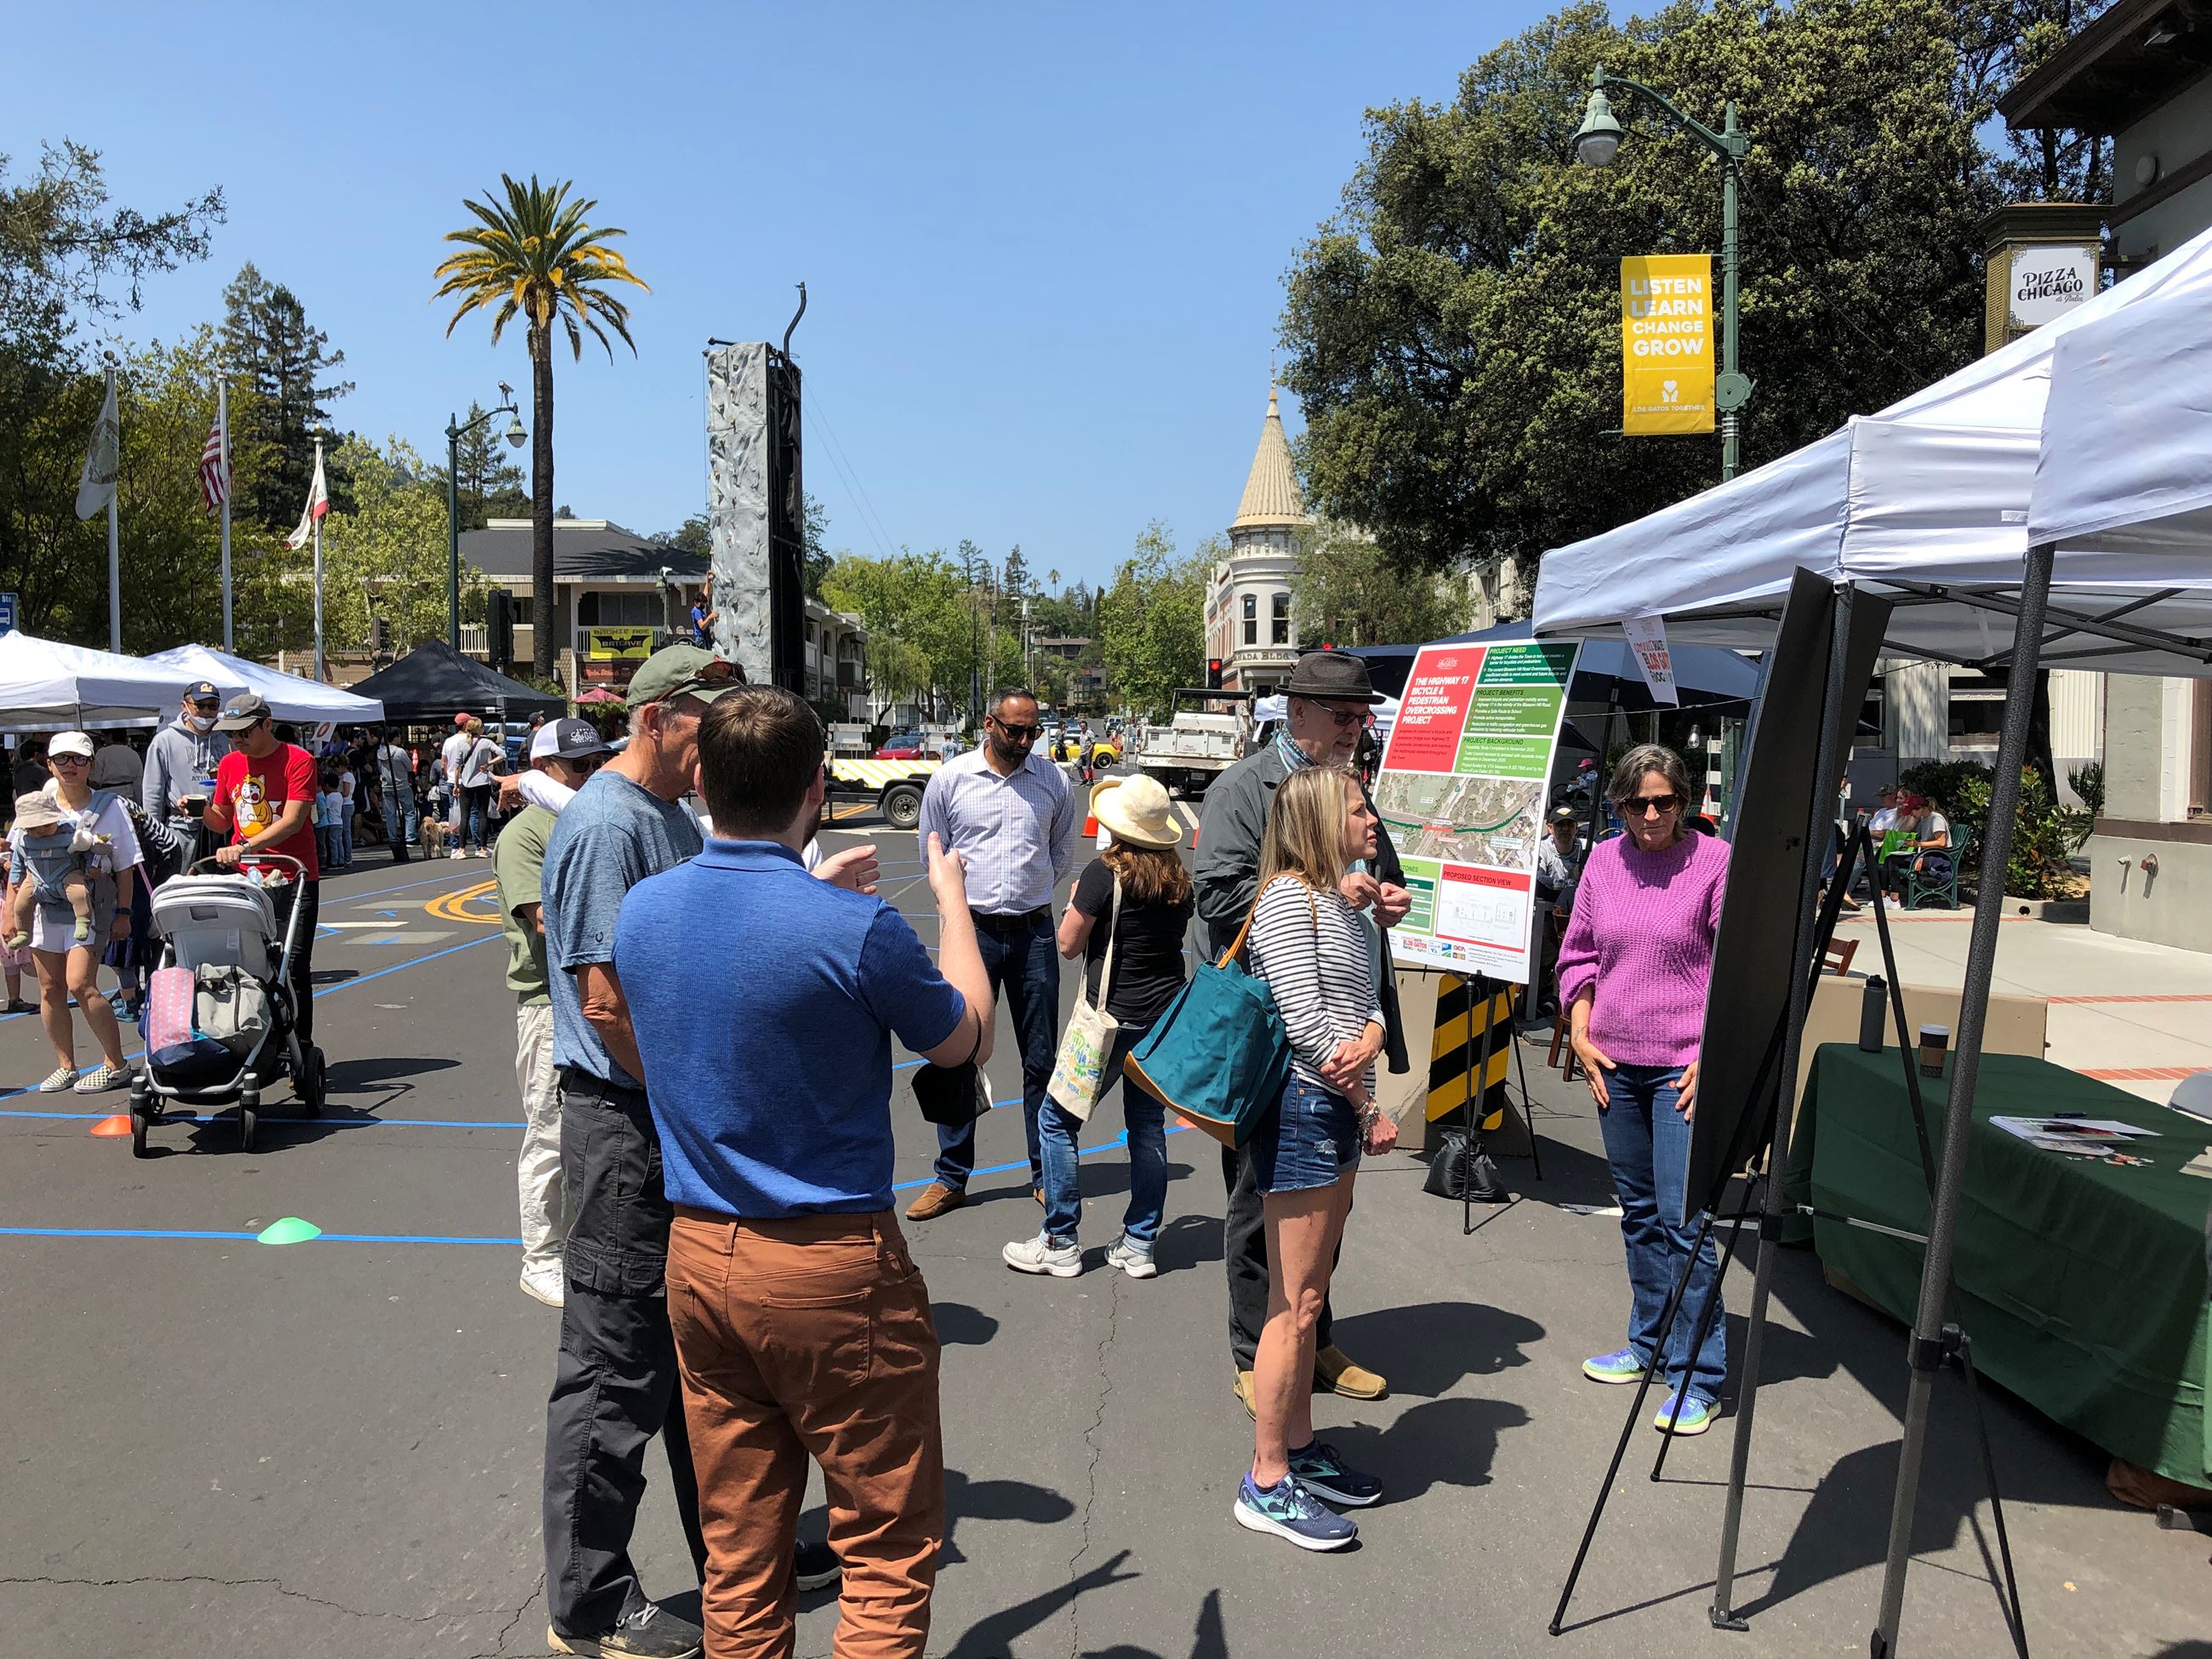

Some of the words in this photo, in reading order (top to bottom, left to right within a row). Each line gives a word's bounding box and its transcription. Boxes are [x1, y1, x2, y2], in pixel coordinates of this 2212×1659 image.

[2022, 267, 2076, 287] PIZZA
[1630, 279, 1701, 295] LISTEN
[2018, 279, 2083, 301] CHICAGO
[1631, 299, 1703, 317] LEARN
[1632, 321, 1704, 334] CHANGE
[1633, 338, 1704, 357] GROW
[1415, 677, 1427, 686] THE
[1429, 676, 1460, 685] HIGHWAY
[1461, 676, 1469, 684] 17
[1411, 686, 1438, 695] BICYCLE
[1408, 696, 1449, 705] PEDESTRIAN
[1405, 706, 1457, 714] OVERCROSSING
[1402, 716, 1432, 724] PROJECT
[1443, 871, 1472, 881] PROPOSED
[1473, 873, 1496, 885] SECTION
[1497, 878, 1512, 886] VIEW
